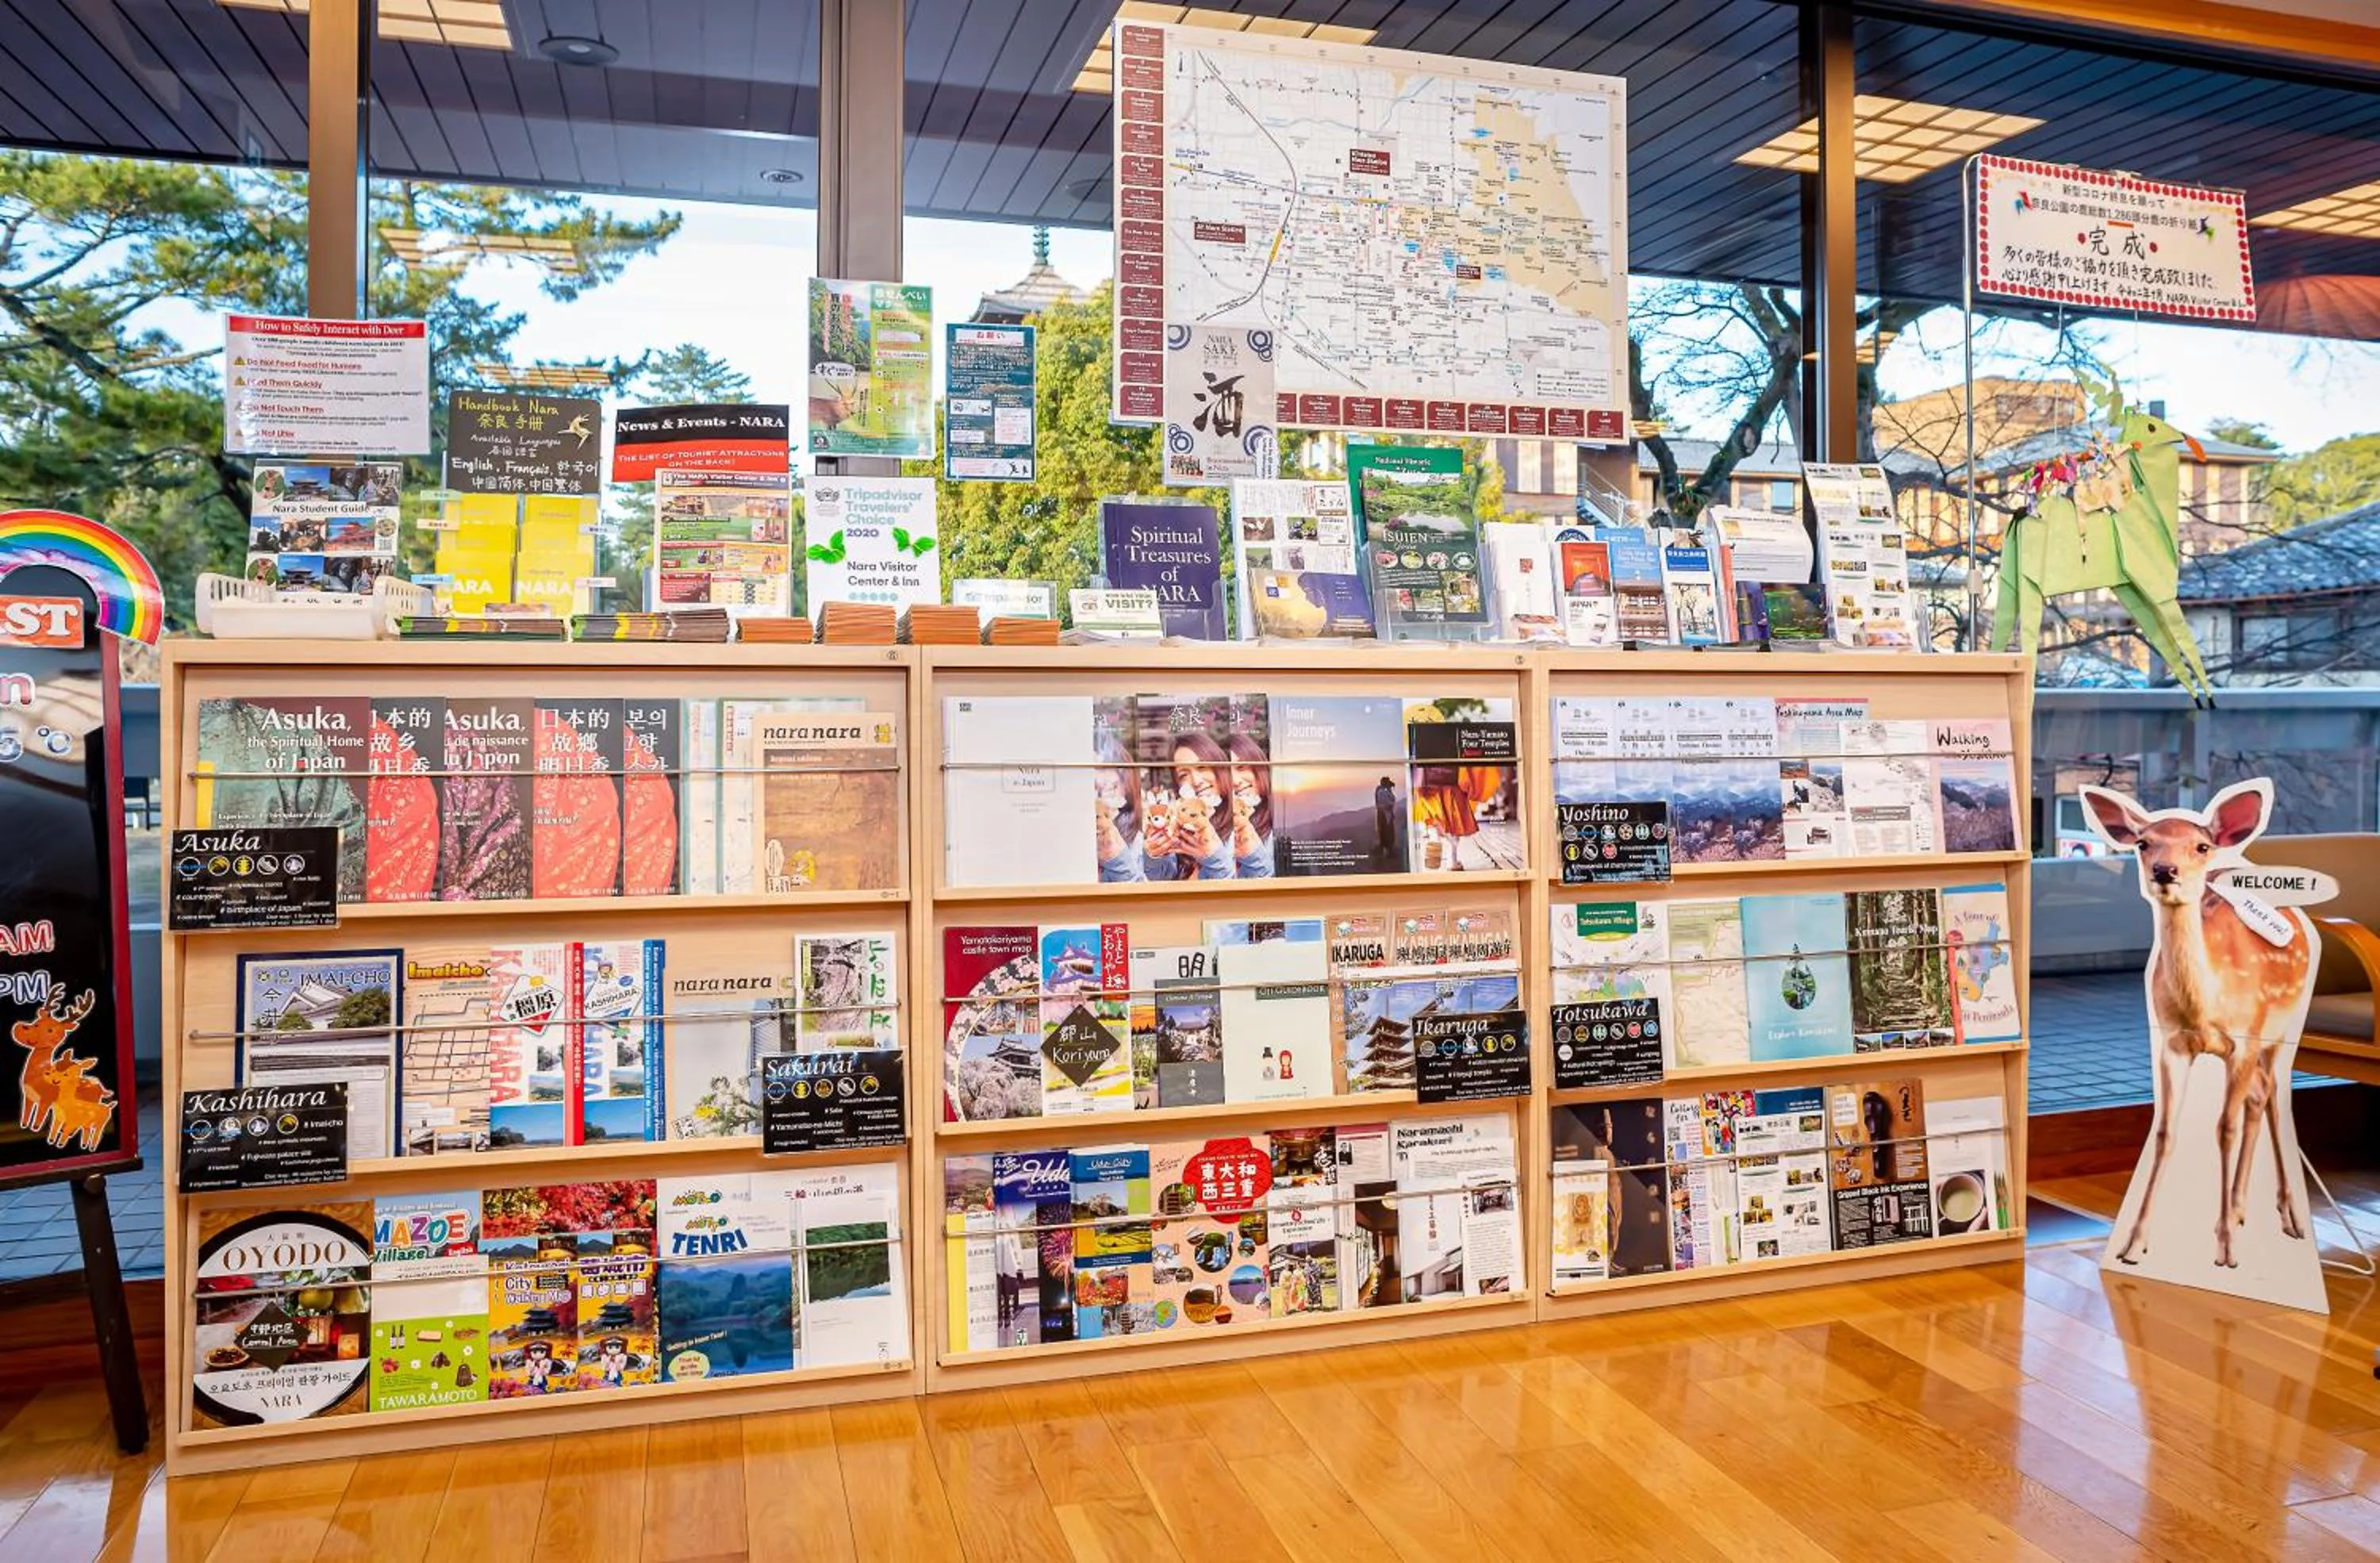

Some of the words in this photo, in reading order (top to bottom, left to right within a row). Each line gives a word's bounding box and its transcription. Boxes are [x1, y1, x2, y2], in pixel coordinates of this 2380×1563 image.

[255, 320, 278, 330] How
[282, 322, 291, 331] to
[293, 322, 321, 336] Safely
[324, 323, 359, 334] Interact
[362, 324, 381, 334] with
[382, 325, 404, 335] Deer
[1203, 344, 1238, 355] SAKE
[459, 398, 520, 413] Handbook
[529, 399, 559, 415] Nara
[617, 421, 658, 432] News
[661, 419, 674, 429] &
[677, 417, 727, 429] Events
[739, 417, 785, 428] NARA
[618, 454, 637, 463] THE
[678, 451, 717, 459] TOURIST
[720, 448, 785, 458] ATTRACTIONS
[844, 487, 922, 501] Tripadvisor
[272, 504, 297, 513] Nara
[299, 504, 337, 513] Student
[340, 503, 370, 513] Guide
[846, 513, 896, 525] Choice
[846, 528, 880, 538] 2020
[1130, 525, 1203, 547] Spiritual
[1383, 530, 1428, 543] ISUIEN
[1124, 544, 1211, 564] Treasures
[846, 560, 877, 571] Nara
[879, 560, 918, 572] Visitor
[1161, 566, 1180, 582] of
[516, 580, 574, 596] NARA
[848, 575, 889, 586] Center
[892, 576, 900, 586] &
[902, 576, 920, 586] Inn
[1106, 599, 1153, 609] VISIT?
[0, 602, 78, 636] ST
[261, 705, 351, 732] Asuka,
[369, 707, 432, 729] 本的
[541, 709, 610, 730] 日本的
[1168, 703, 1205, 725] 奈良
[1285, 705, 1315, 721] Inner
[1825, 707, 1843, 716] Area
[1845, 707, 1864, 719] Map
[1286, 721, 1337, 741] Journeys
[1937, 726, 1990, 747] Walking
[247, 735, 267, 747] the
[269, 735, 324, 751] Spiritual
[327, 735, 364, 747] Home
[370, 732, 416, 754] 故乡
[455, 735, 470, 747] de
[472, 735, 529, 747] naissance
[265, 753, 286, 769] of
[1560, 804, 1630, 824] Yoshino
[175, 829, 262, 853] Asuka
[2232, 875, 2305, 890] WELCOME
[1919, 923, 1940, 935] Map
[962, 946, 987, 954] castle
[1012, 945, 1032, 955] map
[1332, 943, 1385, 963] IKARUGA
[300, 970, 391, 986] IMAI-CHO
[407, 961, 486, 980] Imaicho
[1553, 1002, 1649, 1023] Totsukawa
[1415, 1016, 1489, 1037] Ikaruga
[766, 1054, 855, 1078] Sakurai
[1052, 1046, 1111, 1070] Koriyama
[185, 1086, 327, 1114] Kashihara
[1396, 1123, 1464, 1138] Naramachi
[673, 1229, 748, 1256] TENRI
[222, 1240, 347, 1270] OYODO
[505, 1277, 532, 1291] City
[259, 1393, 304, 1408] NARA
[379, 1389, 478, 1409] TAWARAMOTO
